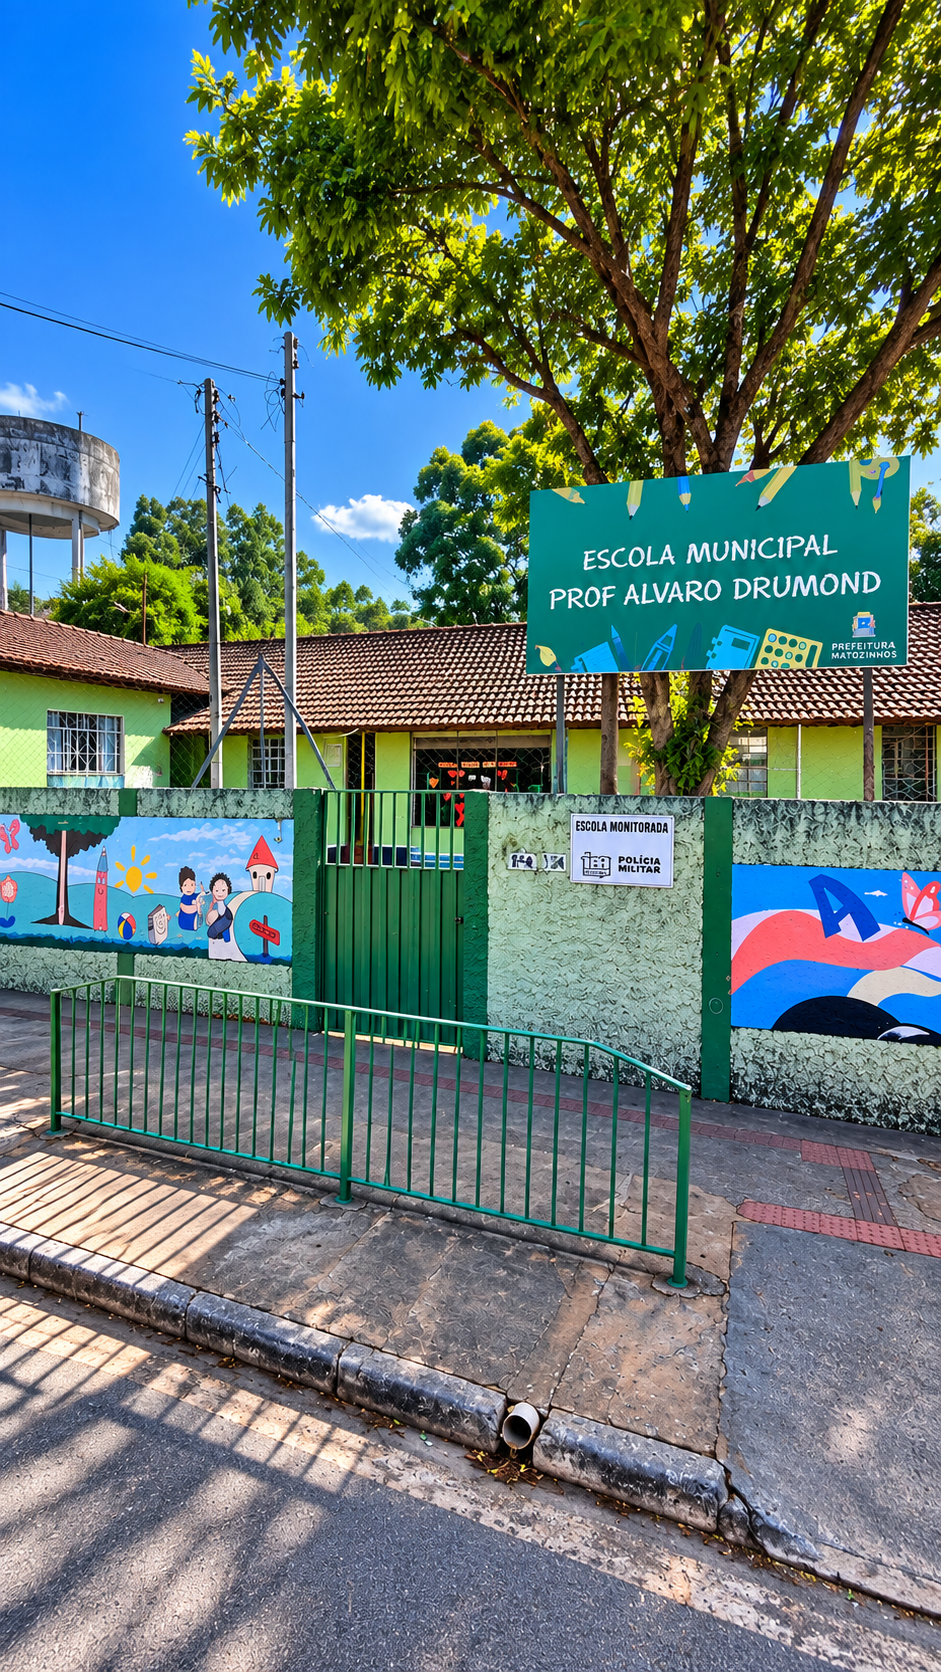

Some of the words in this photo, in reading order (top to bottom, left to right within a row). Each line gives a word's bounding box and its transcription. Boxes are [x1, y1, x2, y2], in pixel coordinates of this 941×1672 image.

[582, 544, 676, 571] ESCOLA
[686, 534, 838, 564] MUNICIPAL
[549, 585, 616, 610] PROF
[623, 579, 722, 606] ALVARO
[733, 571, 882, 601] DRUMOND
[831, 641, 896, 650] PREFEITURA
[831, 650, 897, 659] MATOZINHOS
[575, 820, 608, 832] ESCOLA
[609, 821, 669, 834] MONITORADA
[618, 855, 661, 865] POLÍCIA
[618, 865, 661, 874] MILITAR
[808, 874, 881, 942] A
